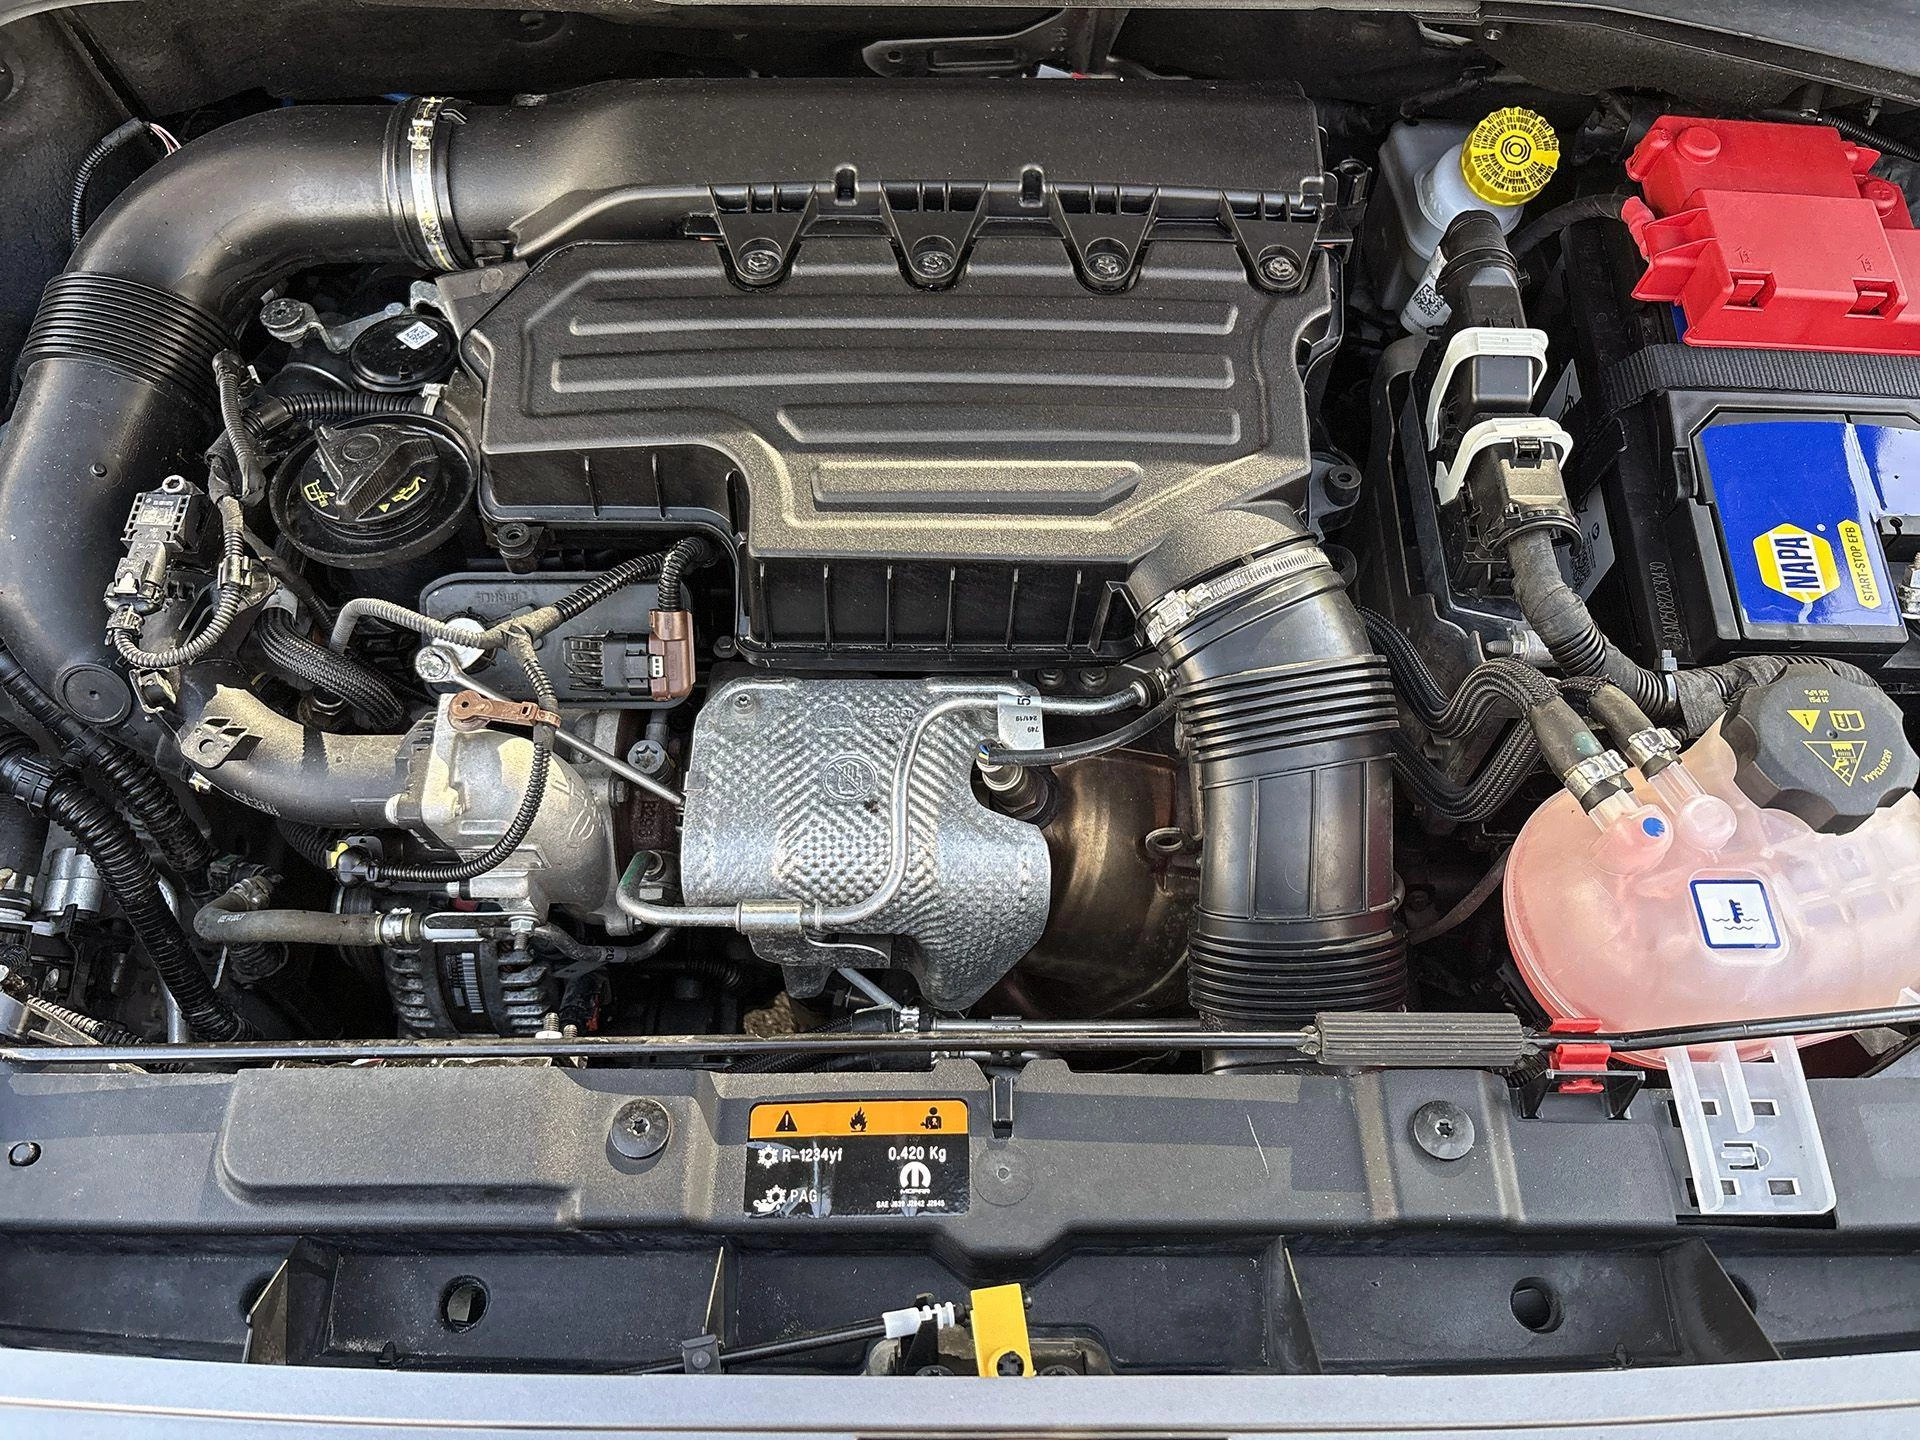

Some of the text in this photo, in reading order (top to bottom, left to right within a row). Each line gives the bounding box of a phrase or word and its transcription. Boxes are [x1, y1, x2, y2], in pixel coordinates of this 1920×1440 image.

[1773, 536, 1820, 589] NAPA
[1845, 526, 1874, 602] START-STOP EFB
[782, 1146, 946, 1164] R-1234yf 0.420 Kg
[790, 1190, 818, 1203] PAG
